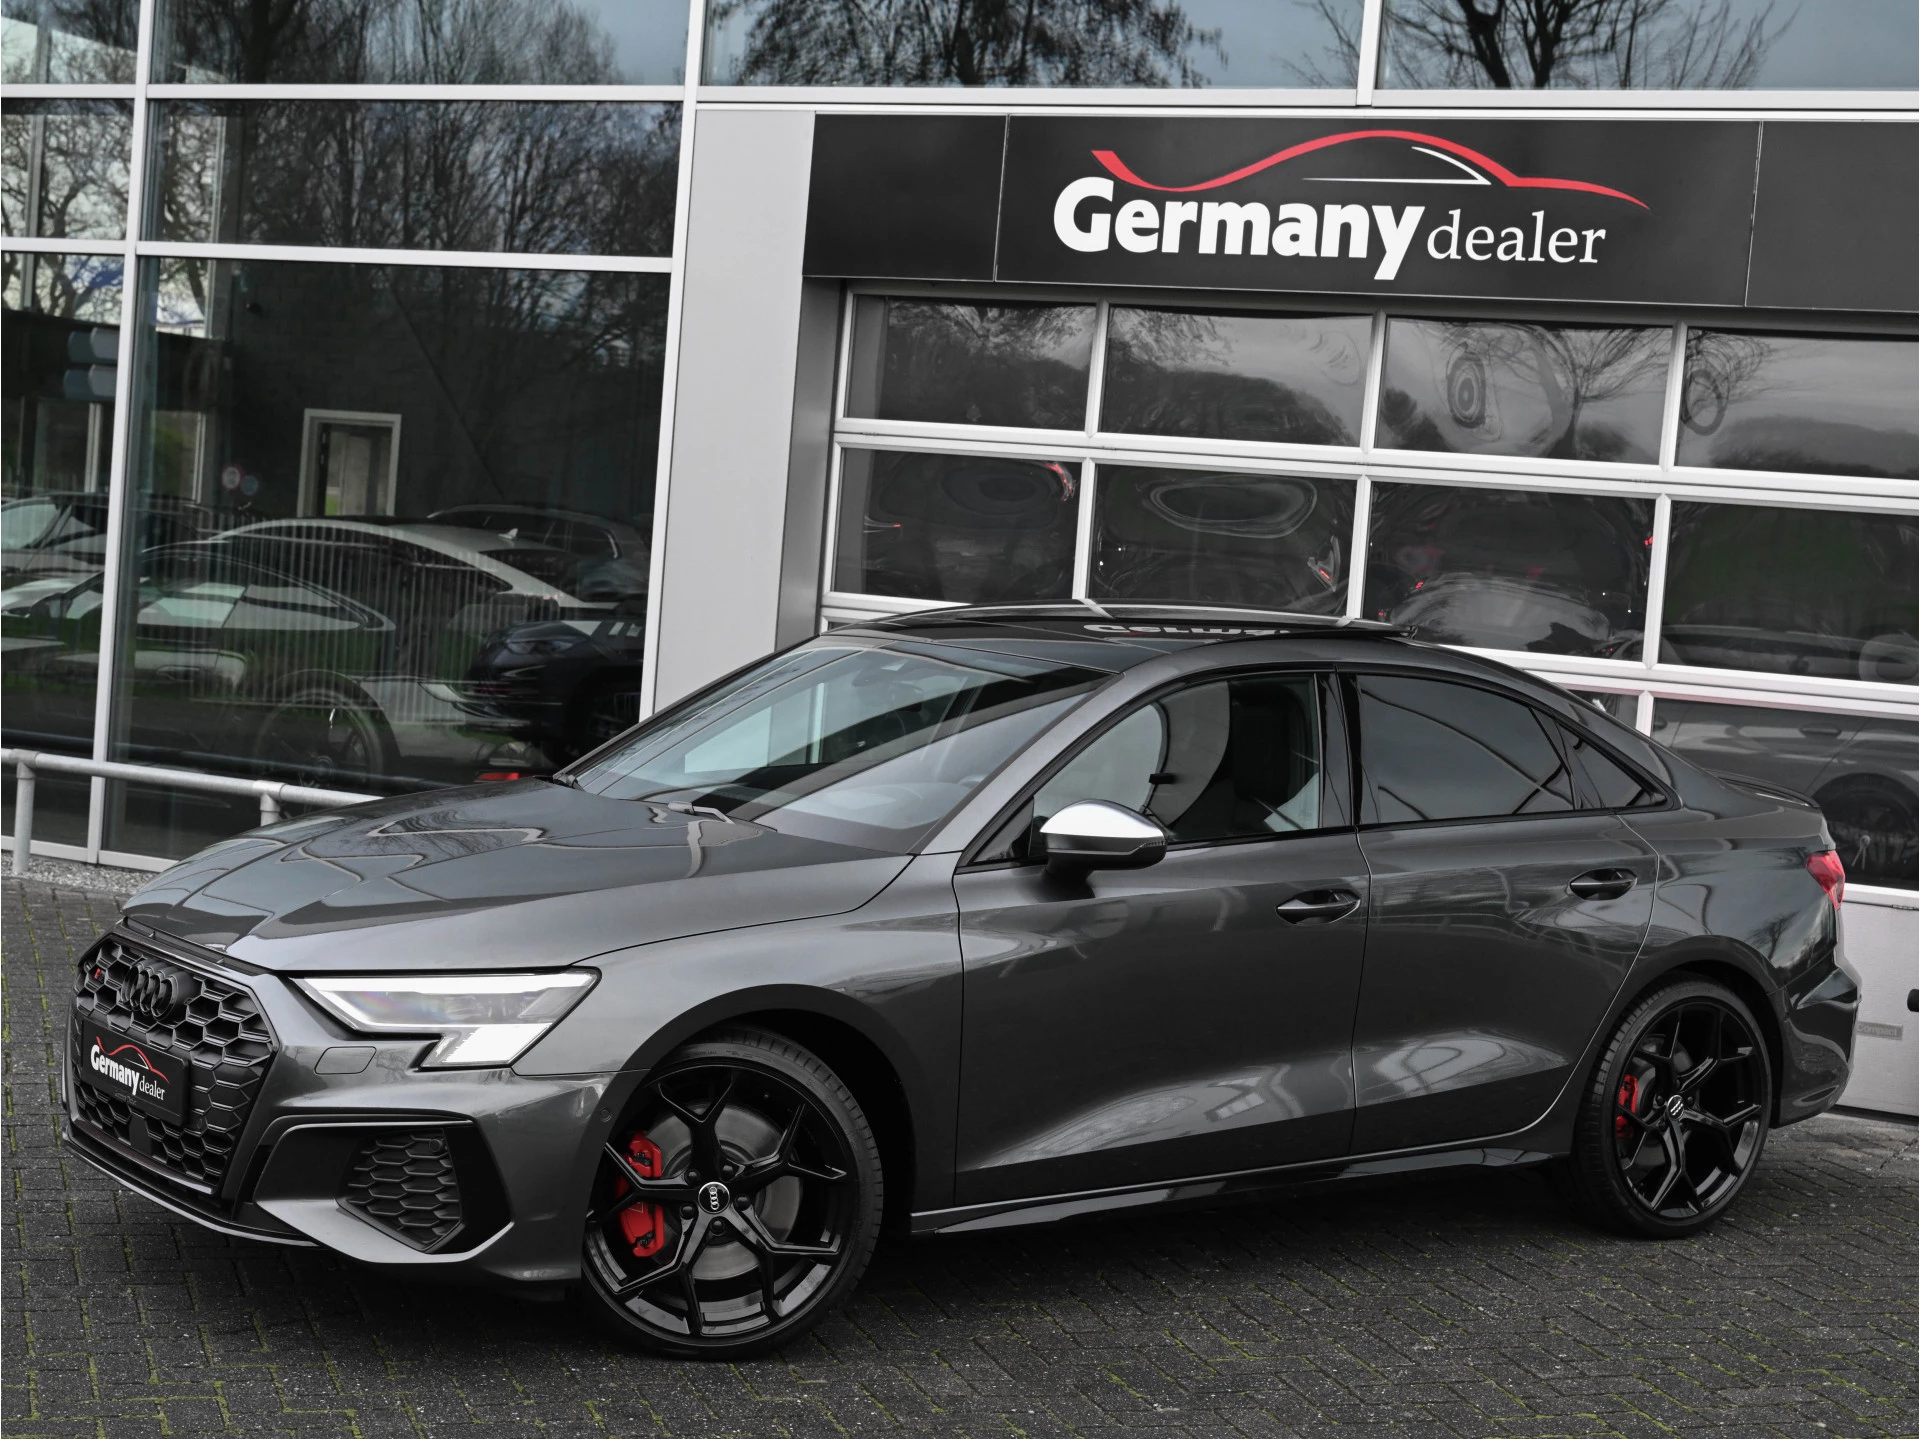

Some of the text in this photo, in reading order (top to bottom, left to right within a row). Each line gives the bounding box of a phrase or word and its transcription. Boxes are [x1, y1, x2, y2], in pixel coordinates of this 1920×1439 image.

[1054, 176, 1607, 281] Germany dealer
[90, 1044, 166, 1101] Germany dealer
